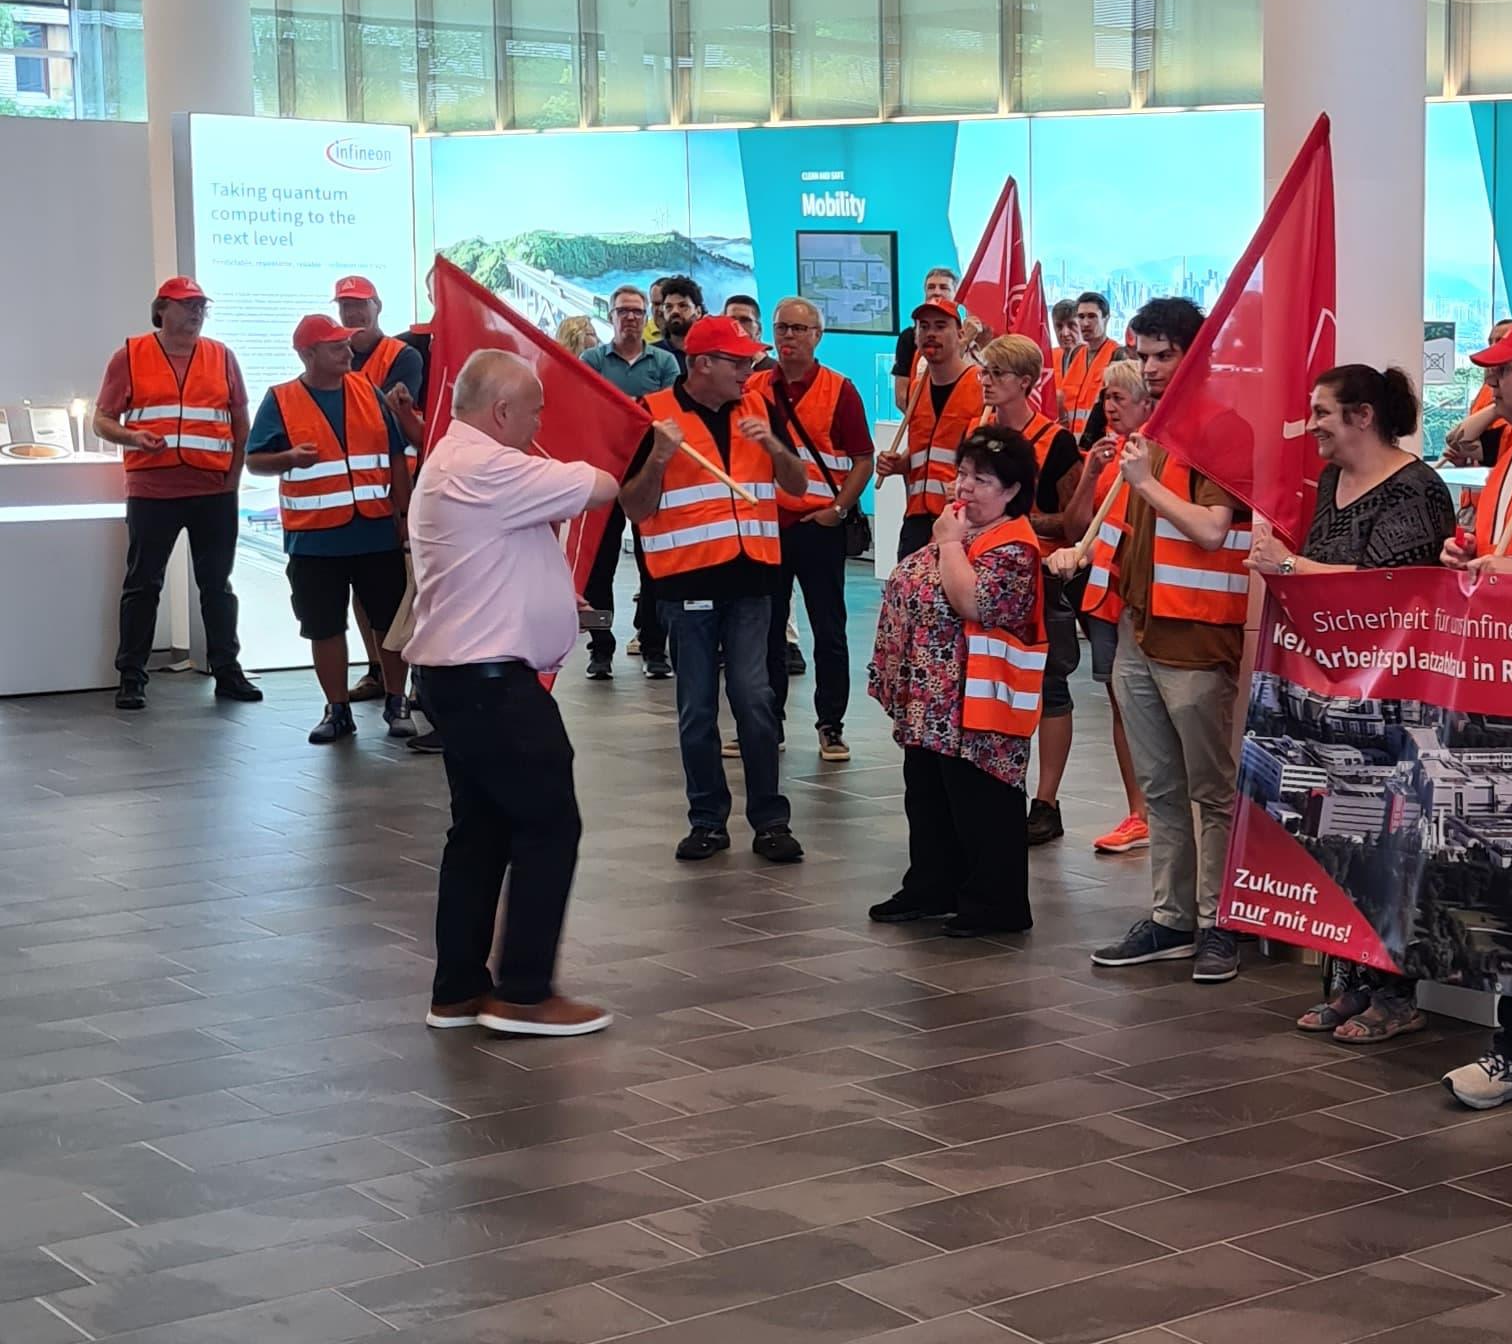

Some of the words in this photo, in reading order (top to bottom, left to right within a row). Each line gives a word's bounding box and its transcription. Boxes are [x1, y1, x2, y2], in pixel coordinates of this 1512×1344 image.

[335, 140, 391, 161] infineon
[211, 182, 267, 201] Taking
[272, 187, 348, 201] quantum
[211, 208, 304, 226] computing
[308, 210, 325, 224] to
[330, 210, 356, 225] the
[801, 190, 866, 224] Mobility
[212, 231, 249, 246] next
[254, 231, 294, 246] level
[1312, 607, 1430, 633] Sicherheit
[1473, 656, 1495, 681] in
[1233, 868, 1318, 905] Zukunft
[1230, 900, 1270, 922] nur
[1272, 911, 1308, 932] mit
[1311, 920, 1352, 943] uns!
